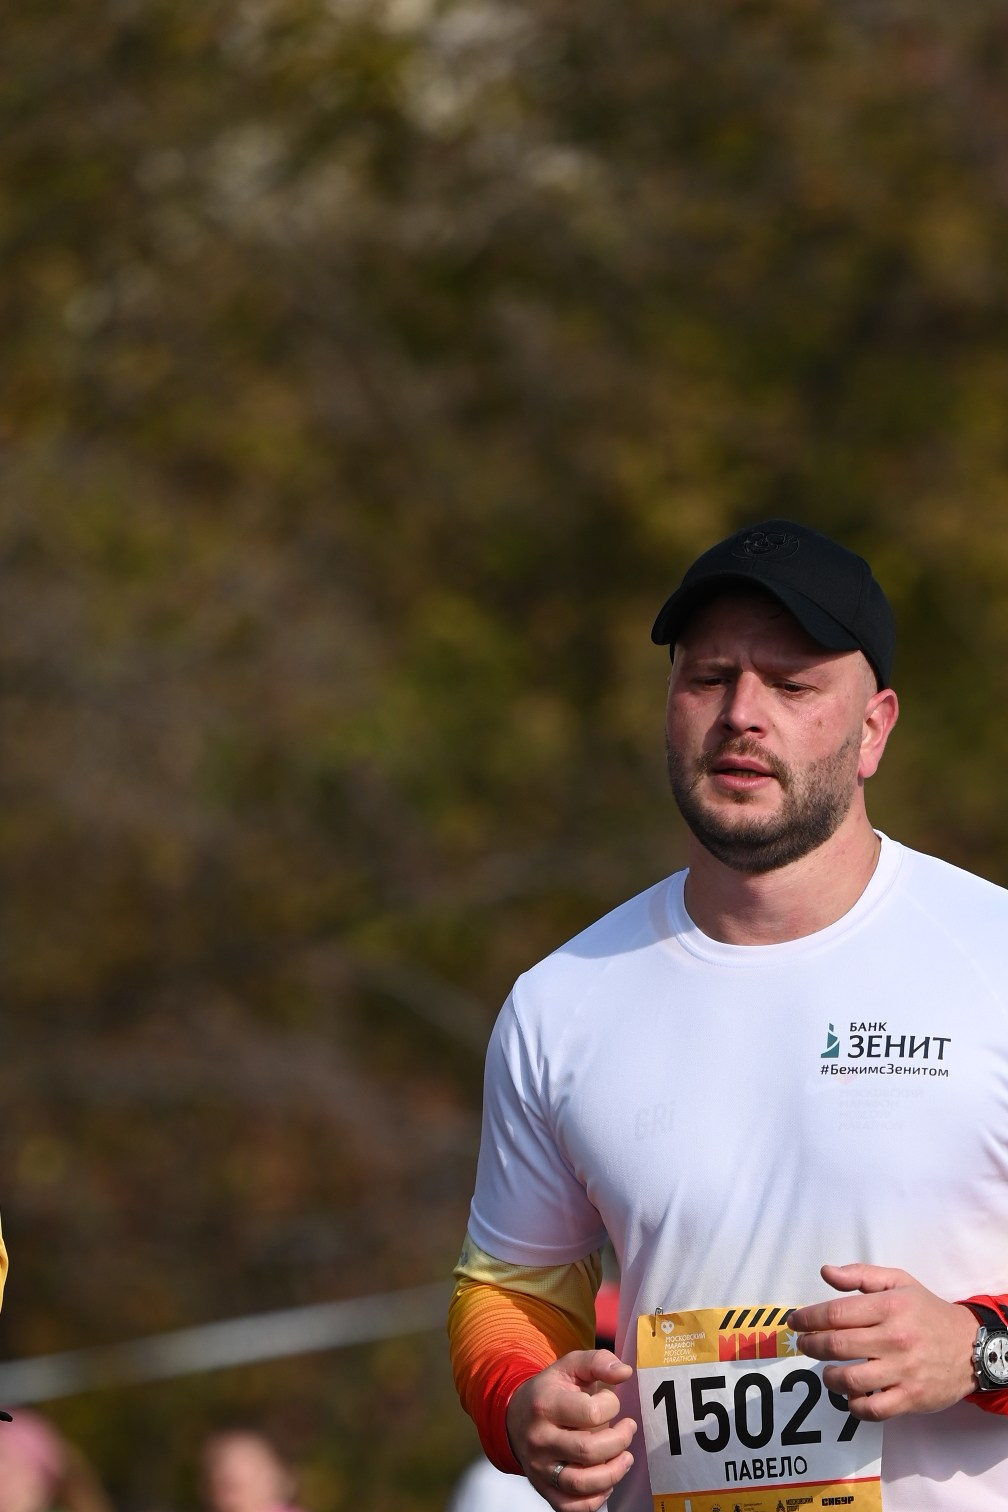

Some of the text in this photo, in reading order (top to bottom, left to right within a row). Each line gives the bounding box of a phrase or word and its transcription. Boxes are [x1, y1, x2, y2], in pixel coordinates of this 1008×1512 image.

[849, 1021, 888, 1032] БАНК
[847, 1034, 952, 1060] ЗЕНИТ
[820, 1063, 949, 1077] #БежимсЗенитом
[665, 1331, 706, 1343] МОСКОВСКИЙ
[664, 1341, 695, 1350] МАРАФОН
[663, 1354, 698, 1363] MARATHON
[724, 1455, 808, 1482] ПАВЕЛО
[821, 1496, 855, 1506] СИБУР
